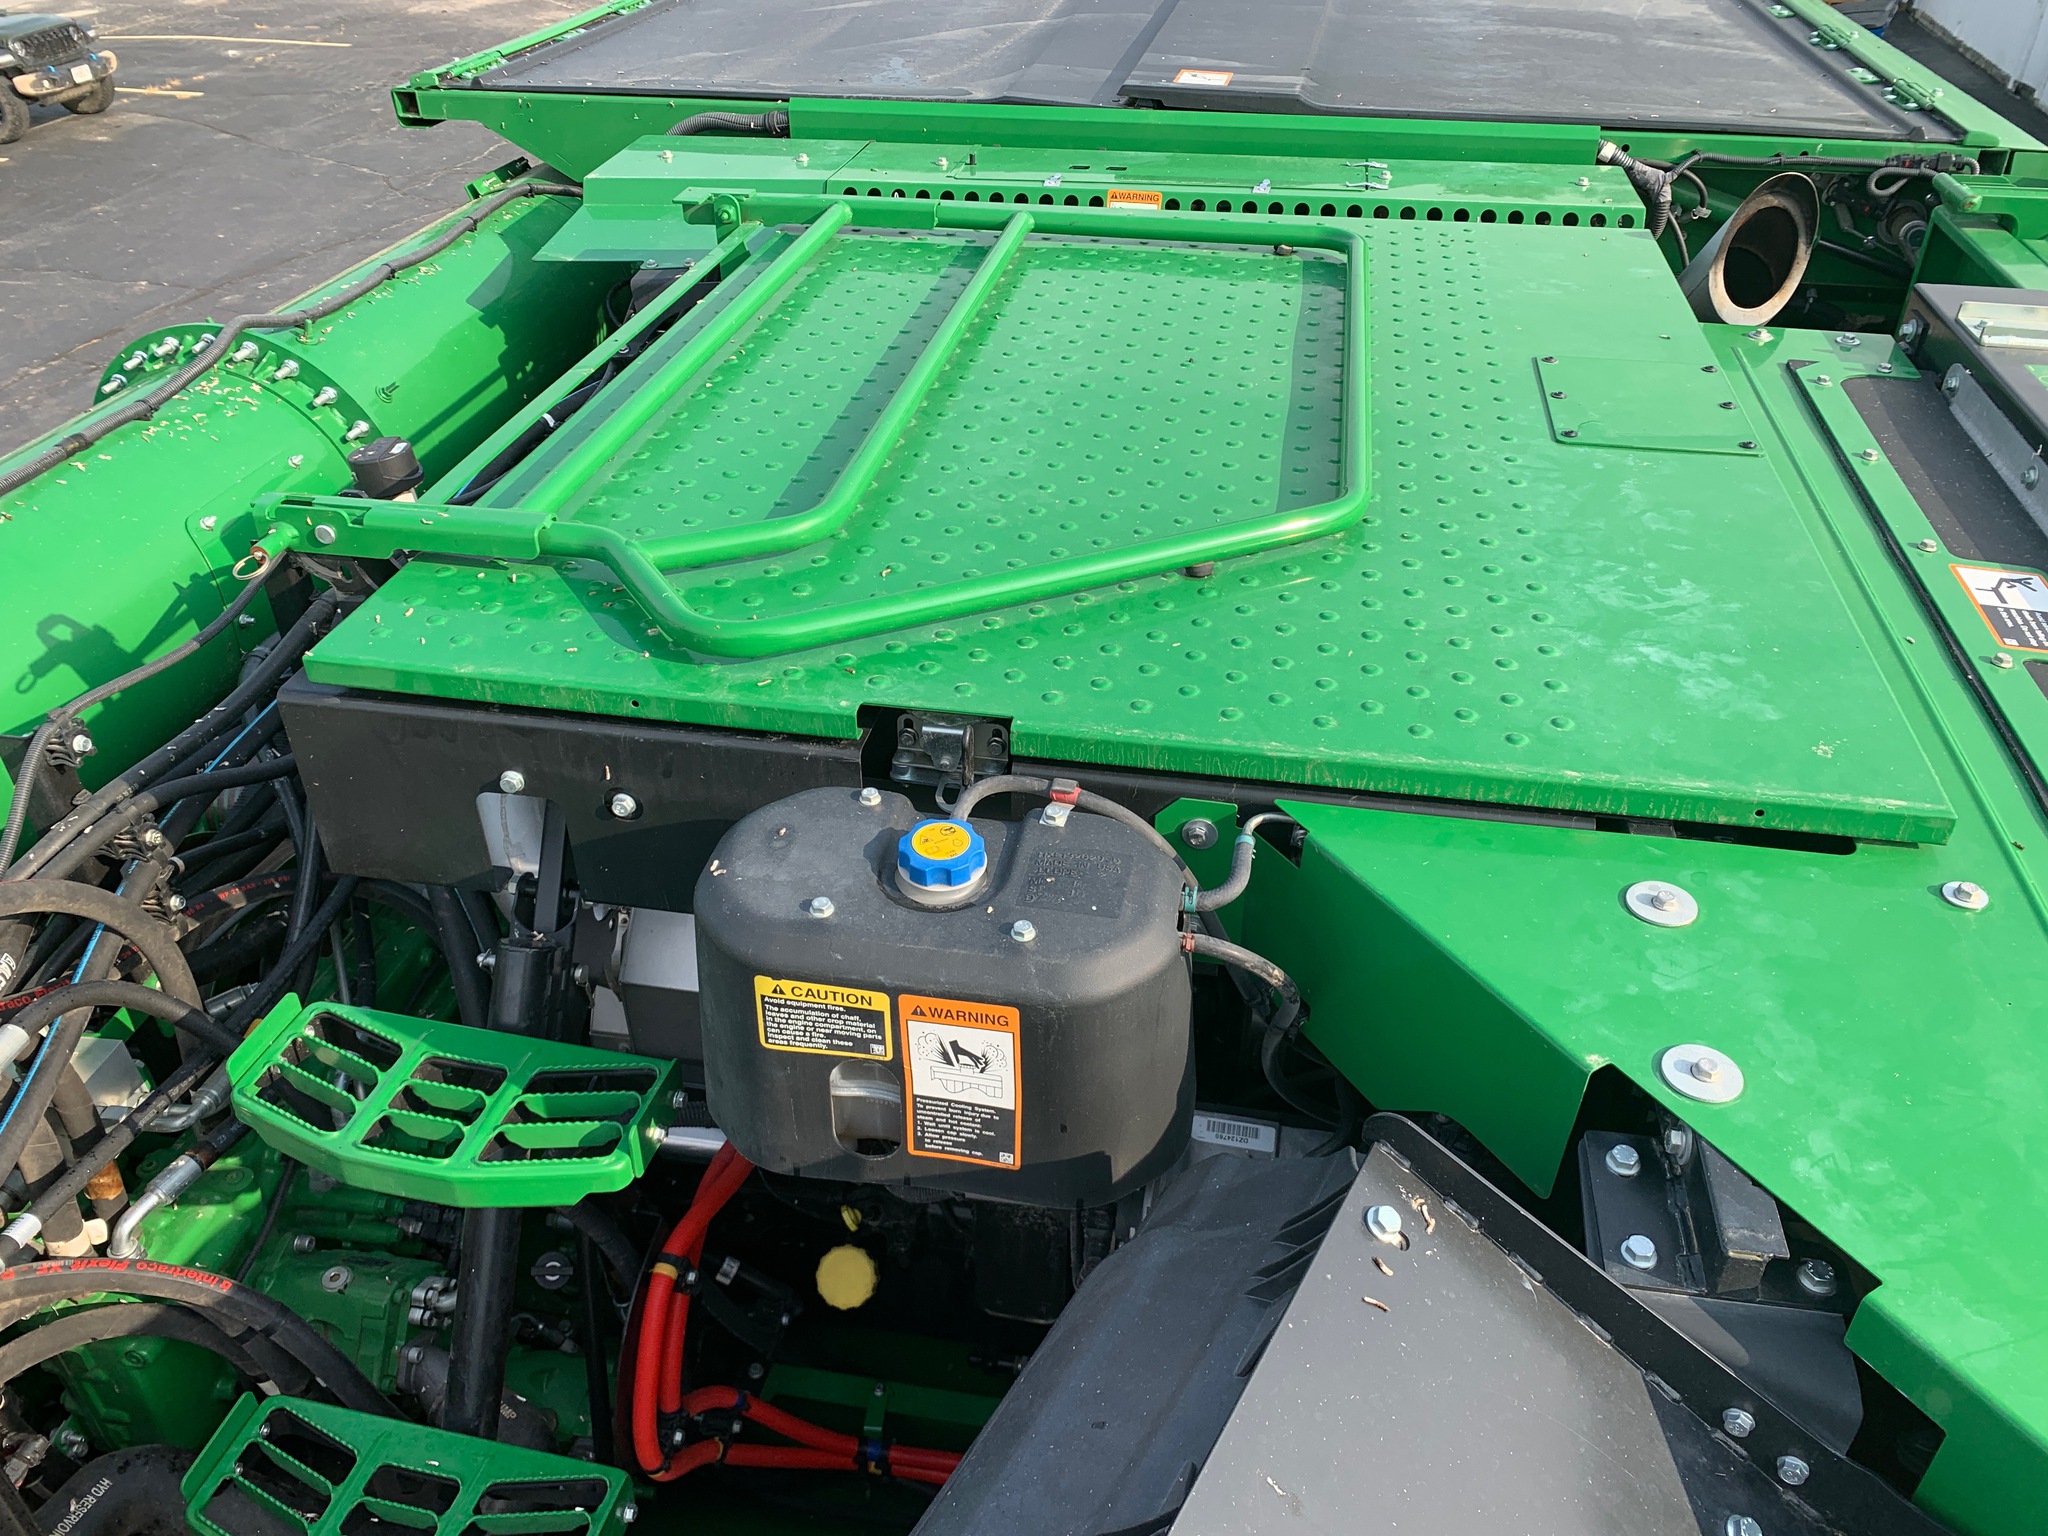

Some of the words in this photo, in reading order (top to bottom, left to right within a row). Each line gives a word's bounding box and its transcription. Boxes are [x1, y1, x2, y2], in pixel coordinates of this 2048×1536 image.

[1119, 193, 1159, 201] WARNING
[791, 987, 872, 1006] CAUTION
[764, 997, 784, 1005] Avoid
[787, 1000, 826, 1010] equipment
[828, 1004, 846, 1012] fires.
[766, 1010, 788, 1018] leaves
[827, 1017, 843, 1025] crop
[846, 1019, 875, 1028] material
[780, 1006, 829, 1017] accumulation
[841, 1013, 861, 1022] chaff,
[929, 1007, 1009, 1027] WARNING
[780, 1023, 805, 1032] engine
[834, 1030, 861, 1038] moving
[788, 1019, 813, 1027] engine
[815, 1022, 865, 1033] compartment,
[790, 1040, 828, 1049] frequently.
[917, 1098, 948, 1106] Pressurized
[951, 1102, 972, 1110] Cooling
[975, 1106, 996, 1114] System.
[942, 1134, 965, 1142] pressure
[959, 1131, 977, 1139] slowly.
[1215, 1133, 1248, 1143] DZ124760
[945, 1146, 969, 1155] removing
[91, 1478, 113, 1498] HYD
